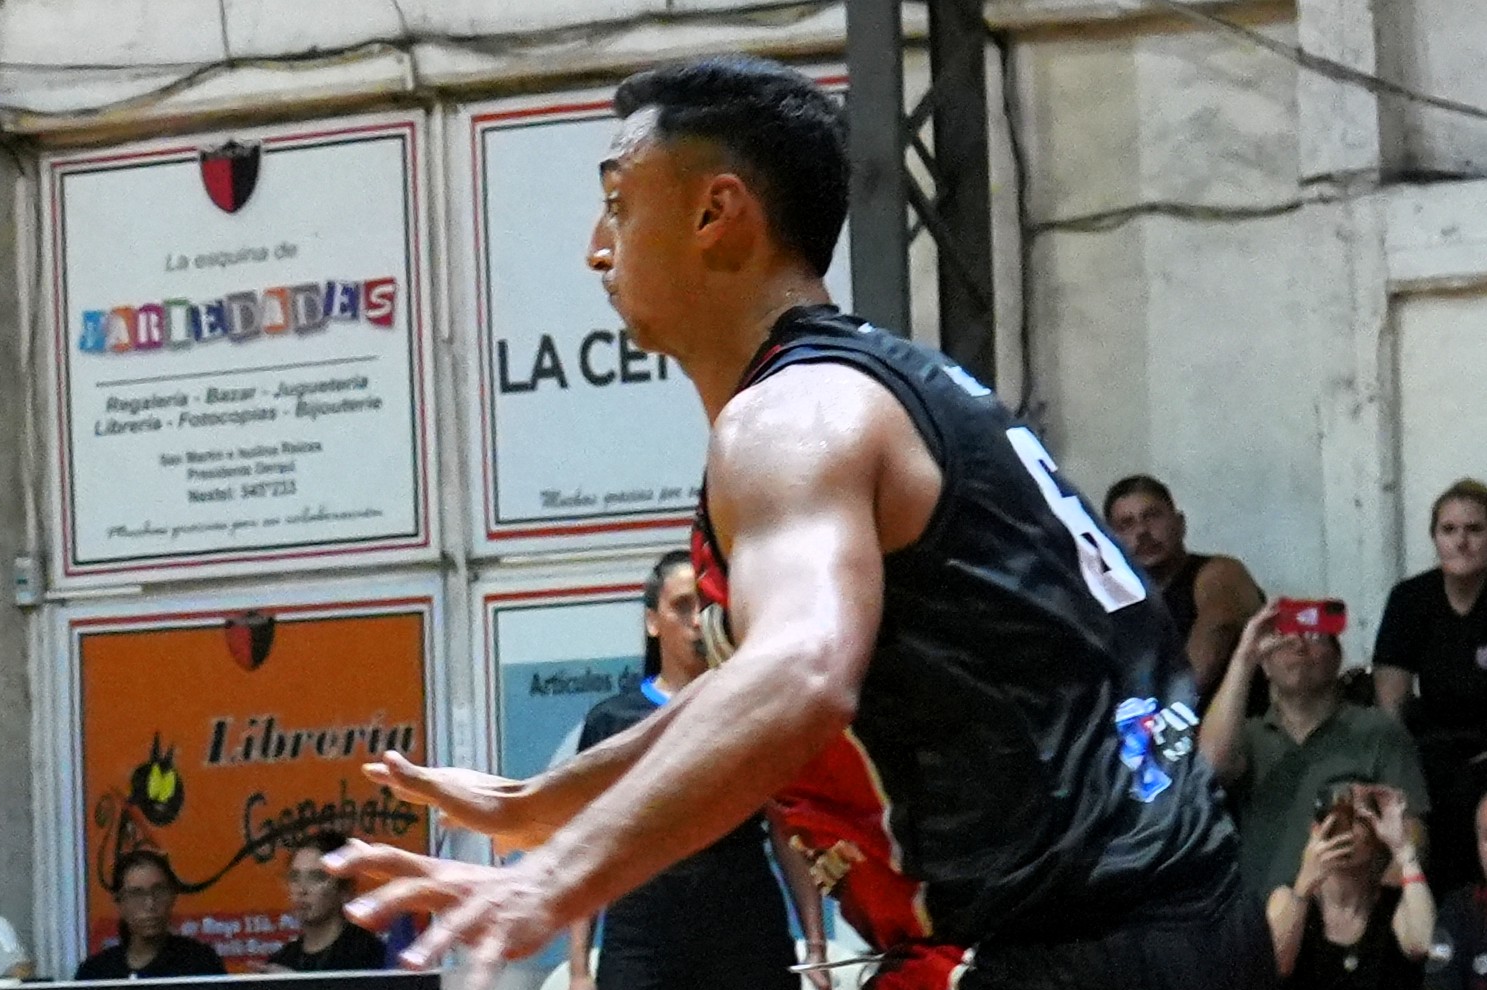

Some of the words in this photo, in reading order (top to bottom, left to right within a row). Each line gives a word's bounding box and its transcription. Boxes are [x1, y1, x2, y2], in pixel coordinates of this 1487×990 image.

[273, 241, 298, 260] de
[497, 333, 568, 394] LA
[206, 387, 256, 404] Bazar
